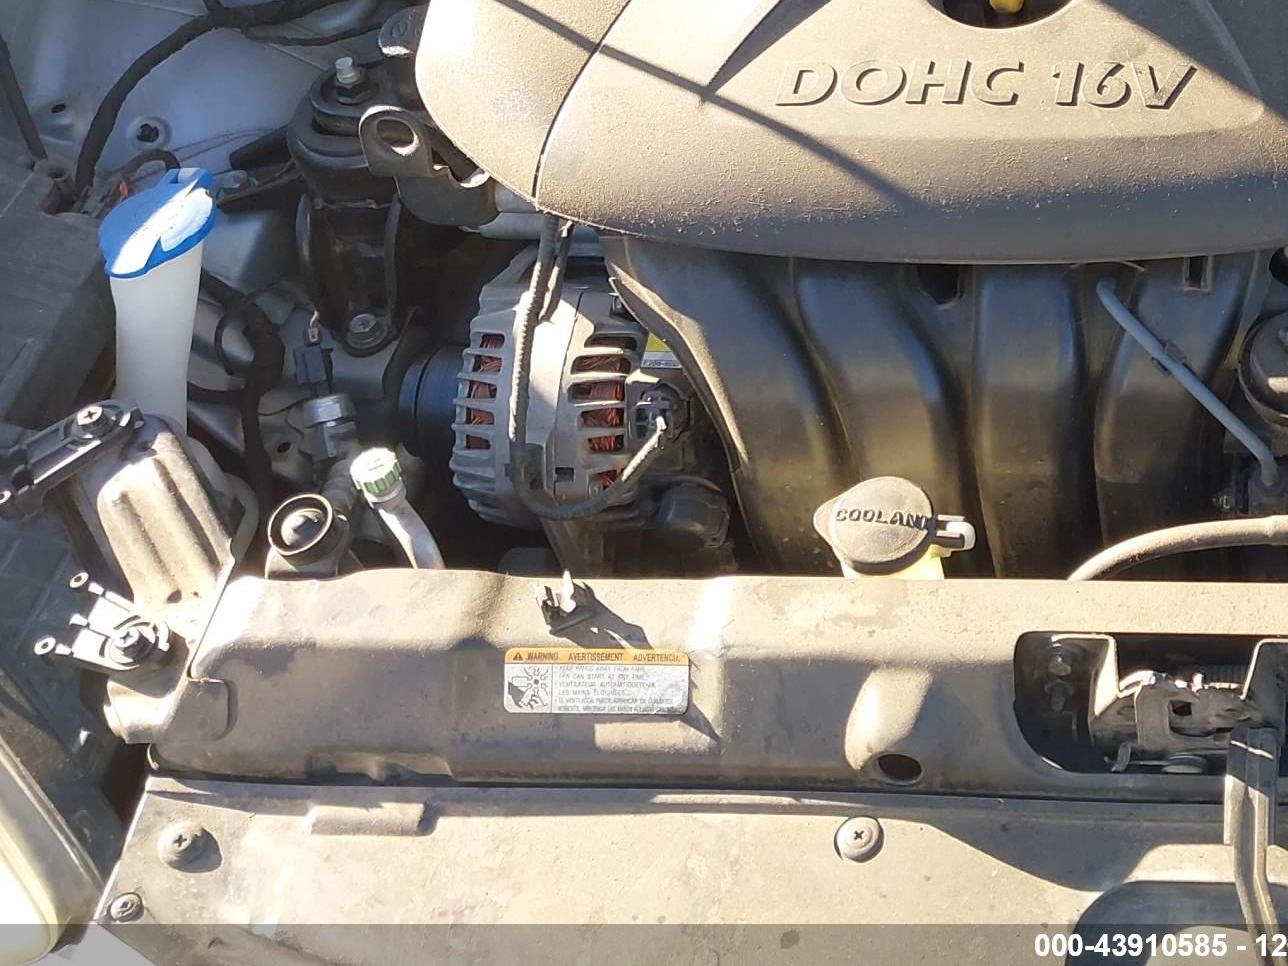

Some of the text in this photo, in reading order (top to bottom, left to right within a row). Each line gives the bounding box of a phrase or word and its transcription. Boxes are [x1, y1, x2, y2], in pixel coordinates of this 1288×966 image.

[774, 58, 1199, 111] DOHC 16V
[528, 651, 680, 663] WARNING AVERTISSEMENT ADVERTENCIA
